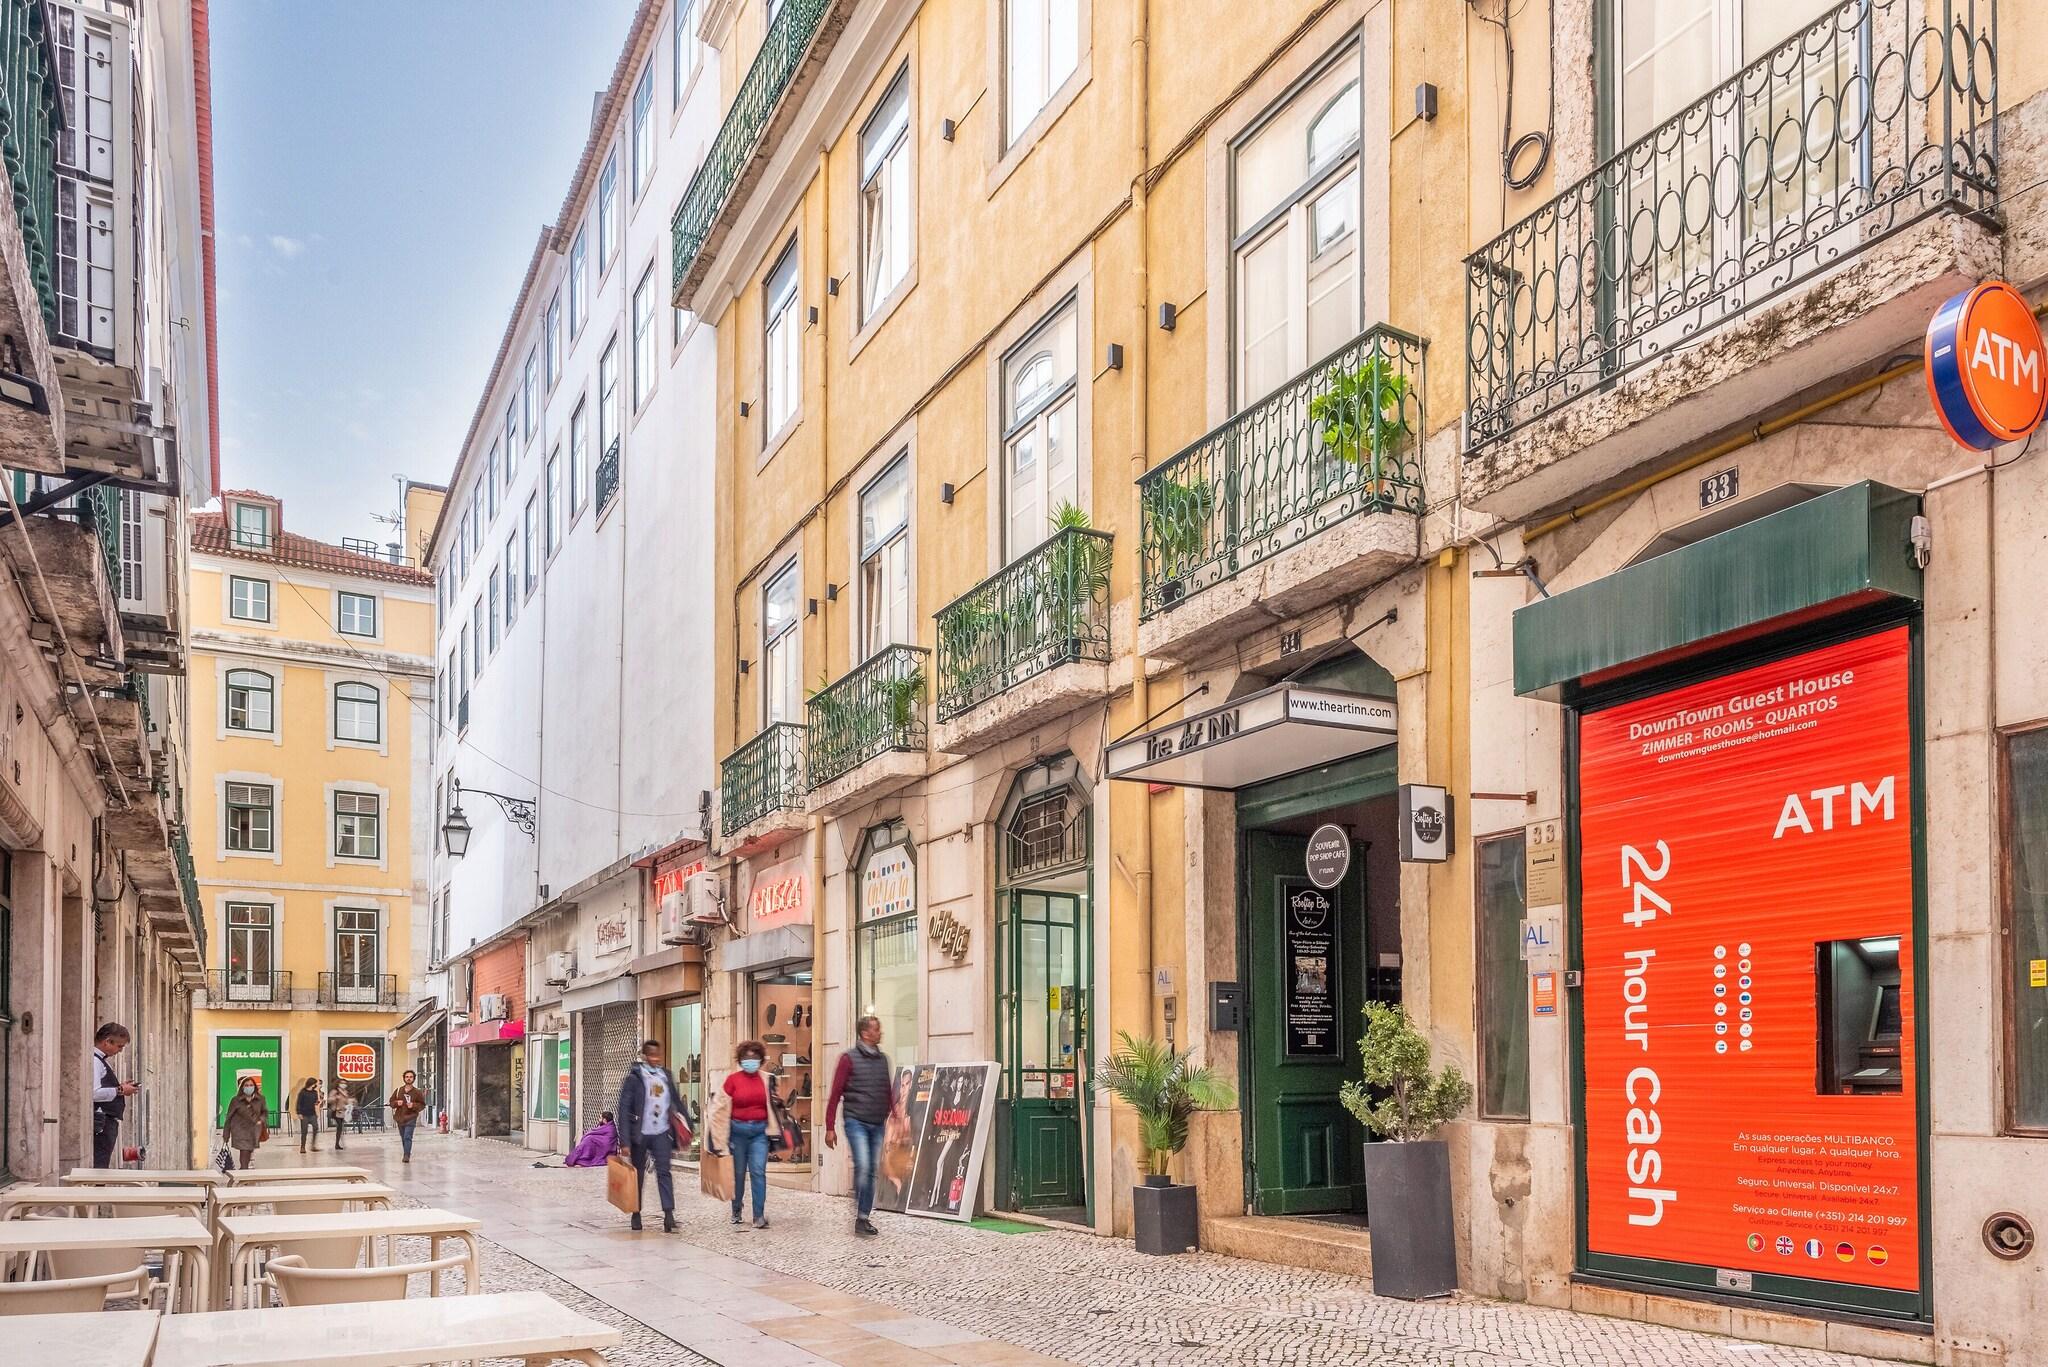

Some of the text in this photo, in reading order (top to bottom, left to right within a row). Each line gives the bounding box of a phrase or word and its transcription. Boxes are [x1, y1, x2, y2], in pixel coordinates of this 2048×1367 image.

[1971, 327, 2038, 394] ATM
[1707, 473, 1730, 504] 33
[1290, 699, 1392, 719] www.theartinn.com
[1629, 670, 1854, 741] DownTown Guest House
[1143, 709, 1240, 762] The Art INN
[1641, 734, 1692, 756] ZIMMER
[1703, 717, 1754, 740] ROOMS
[1766, 696, 1838, 725] QUARTOS
[1658, 719, 1818, 764] downtownguesthouse@hotmail.com
[1773, 776, 1895, 839] ATM
[1533, 825, 1555, 845] 33
[1315, 840, 1340, 851] SOUVENIR
[1309, 853, 1320, 862] POP
[1320, 852, 1332, 861] SHOP
[1291, 896, 1330, 911] Rooftop Bar
[1526, 925, 1549, 945] AL
[1157, 970, 1171, 985] AL
[1621, 839, 1677, 1227] 24 hour cash
[250, 1049, 278, 1058] GRÁTIS
[339, 1055, 374, 1063] BURGER
[339, 1063, 374, 1073] KING
[1739, 1132, 1750, 1140] As
[1774, 1134, 1822, 1144] operações
[1824, 1135, 1896, 1146] MULTIBANCO.
[1733, 1143, 1747, 1151] Em
[1750, 1144, 1788, 1154] qualquer
[1792, 1145, 1817, 1156] lugar.
[1830, 1148, 1873, 1158] qualquer
[1876, 1149, 1901, 1159] hora.
[1758, 1156, 1786, 1166] Express
[1845, 1161, 1872, 1170] money
[1776, 1166, 1853, 1177] Anywhere. Anytime.
[1737, 1176, 1900, 1195] Seguro. Universal. Disponível 24x7.
[1733, 1203, 1765, 1214] Serviço
[1781, 1208, 1813, 1218] Cliente
[1816, 1210, 1846, 1221] (+351)
[1848, 1212, 1865, 1222] 214
[1867, 1214, 1885, 1224] 201
[1887, 1216, 1907, 1226] 997
